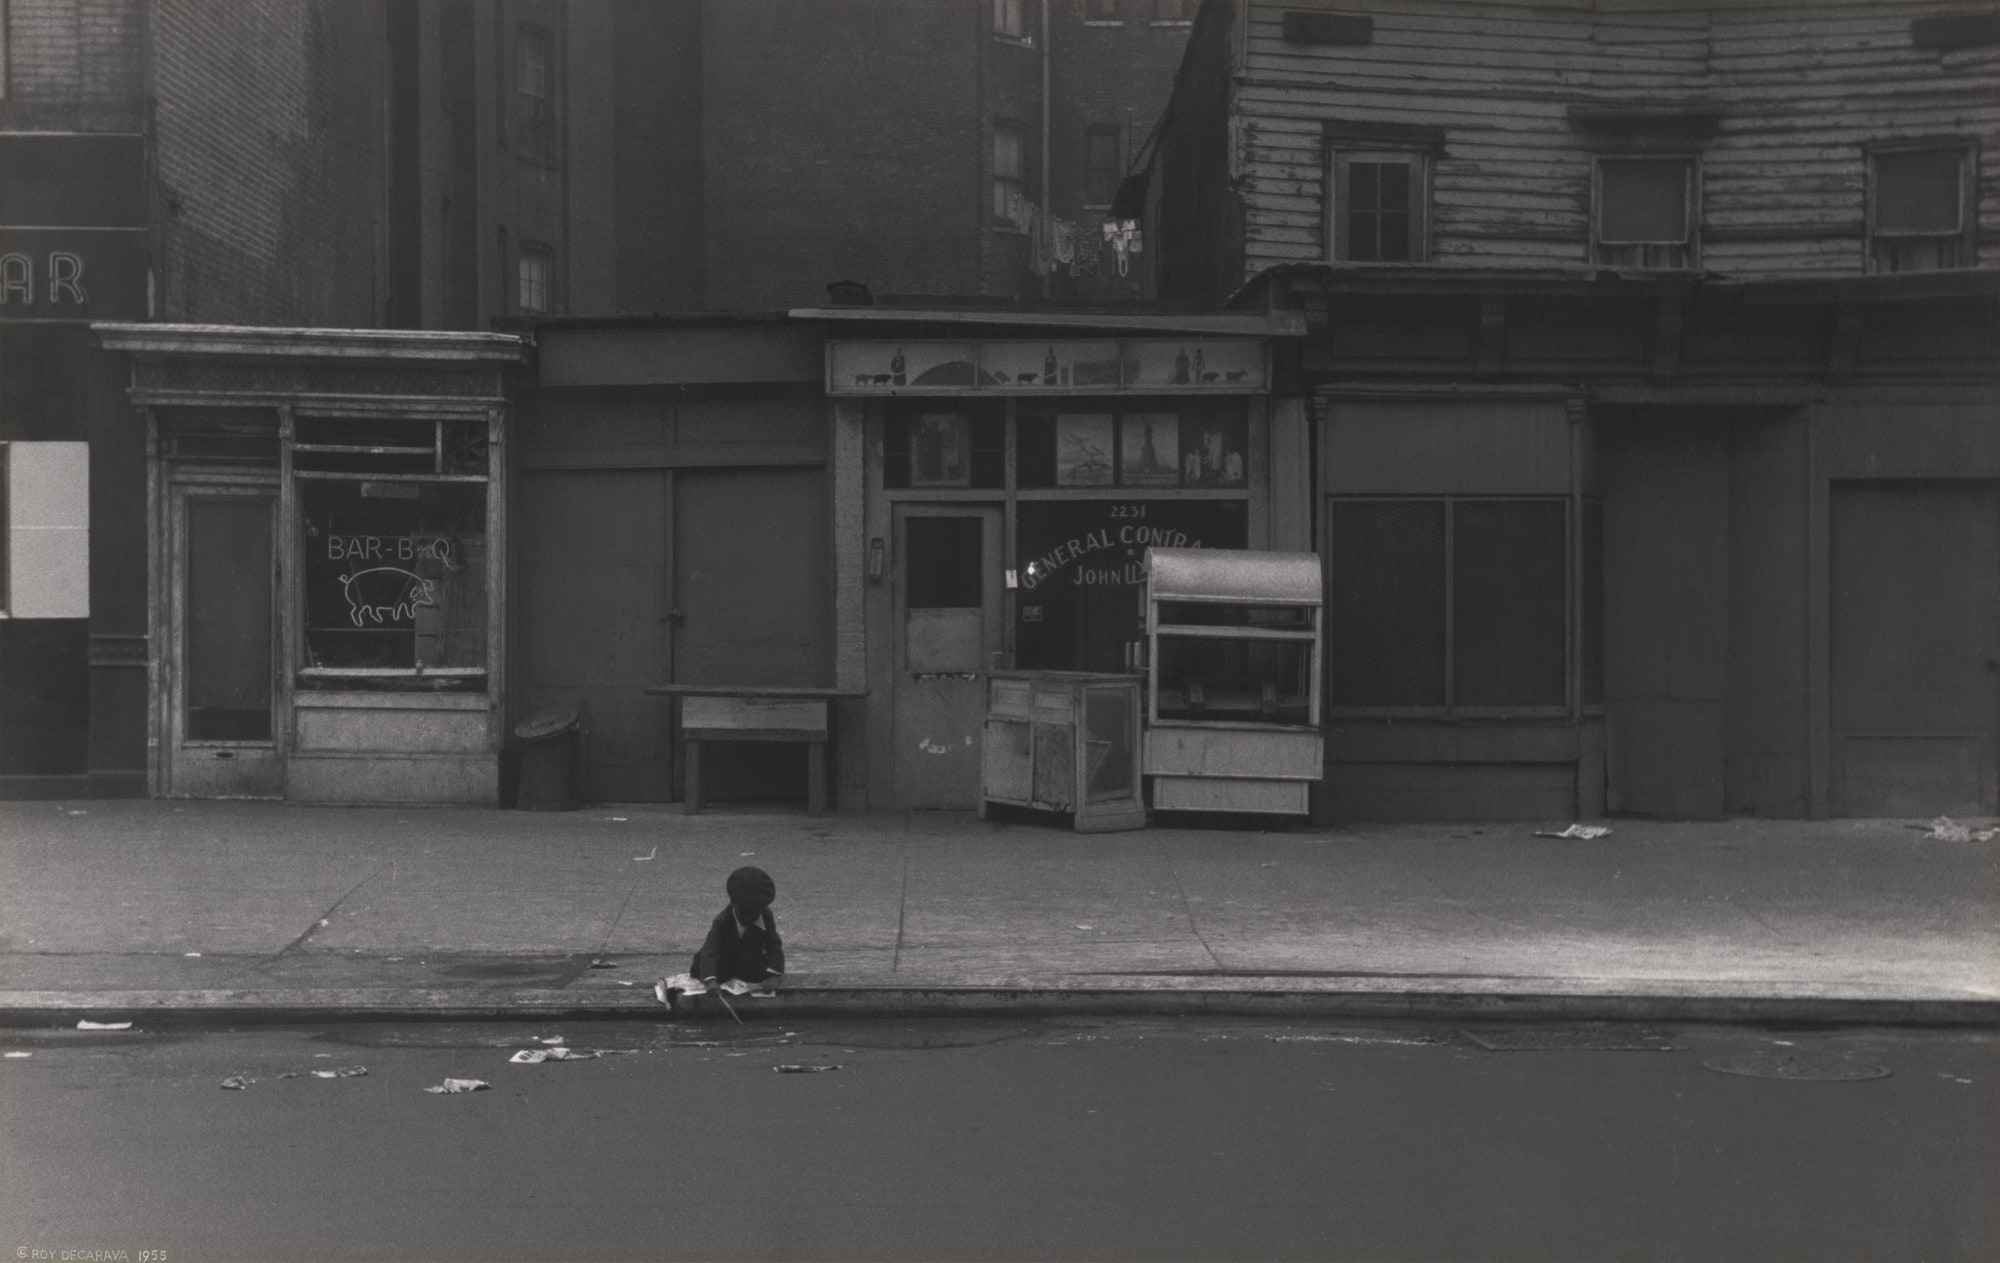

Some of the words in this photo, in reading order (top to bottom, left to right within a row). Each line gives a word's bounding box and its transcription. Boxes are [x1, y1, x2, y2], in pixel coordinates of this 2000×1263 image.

[1111, 505, 1147, 518] 2231
[1021, 528, 1116, 590] GENERAL
[1119, 525, 1203, 549] CONTRA
[1073, 564, 1122, 585] JOHN
